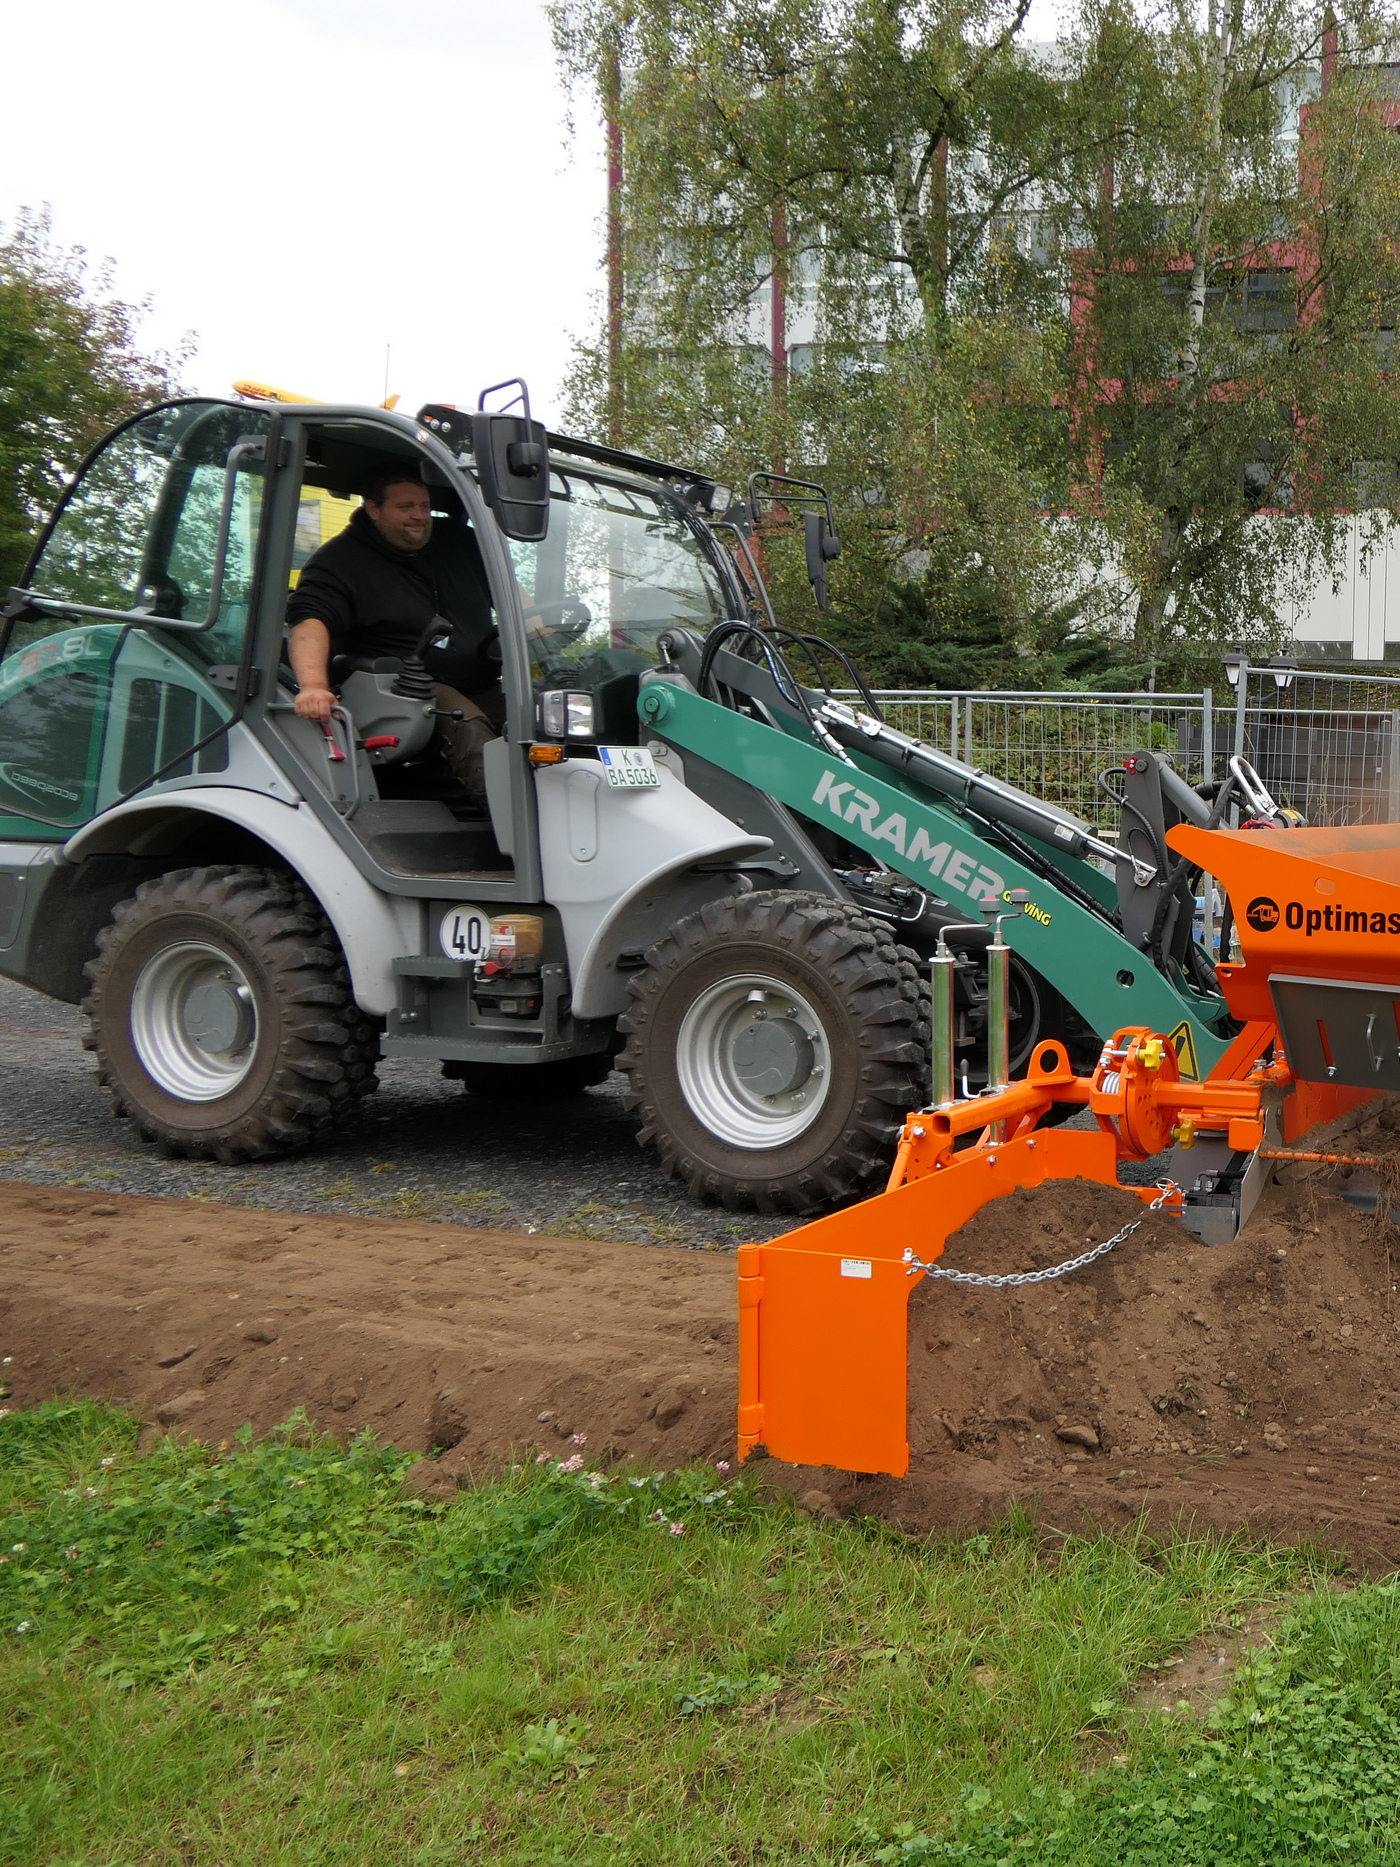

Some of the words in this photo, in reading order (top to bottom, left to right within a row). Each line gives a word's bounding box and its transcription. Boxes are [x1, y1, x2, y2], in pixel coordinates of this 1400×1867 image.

[621, 749, 632, 766] K
[811, 769, 1005, 900] KRAMER
[452, 916, 482, 955] 40
